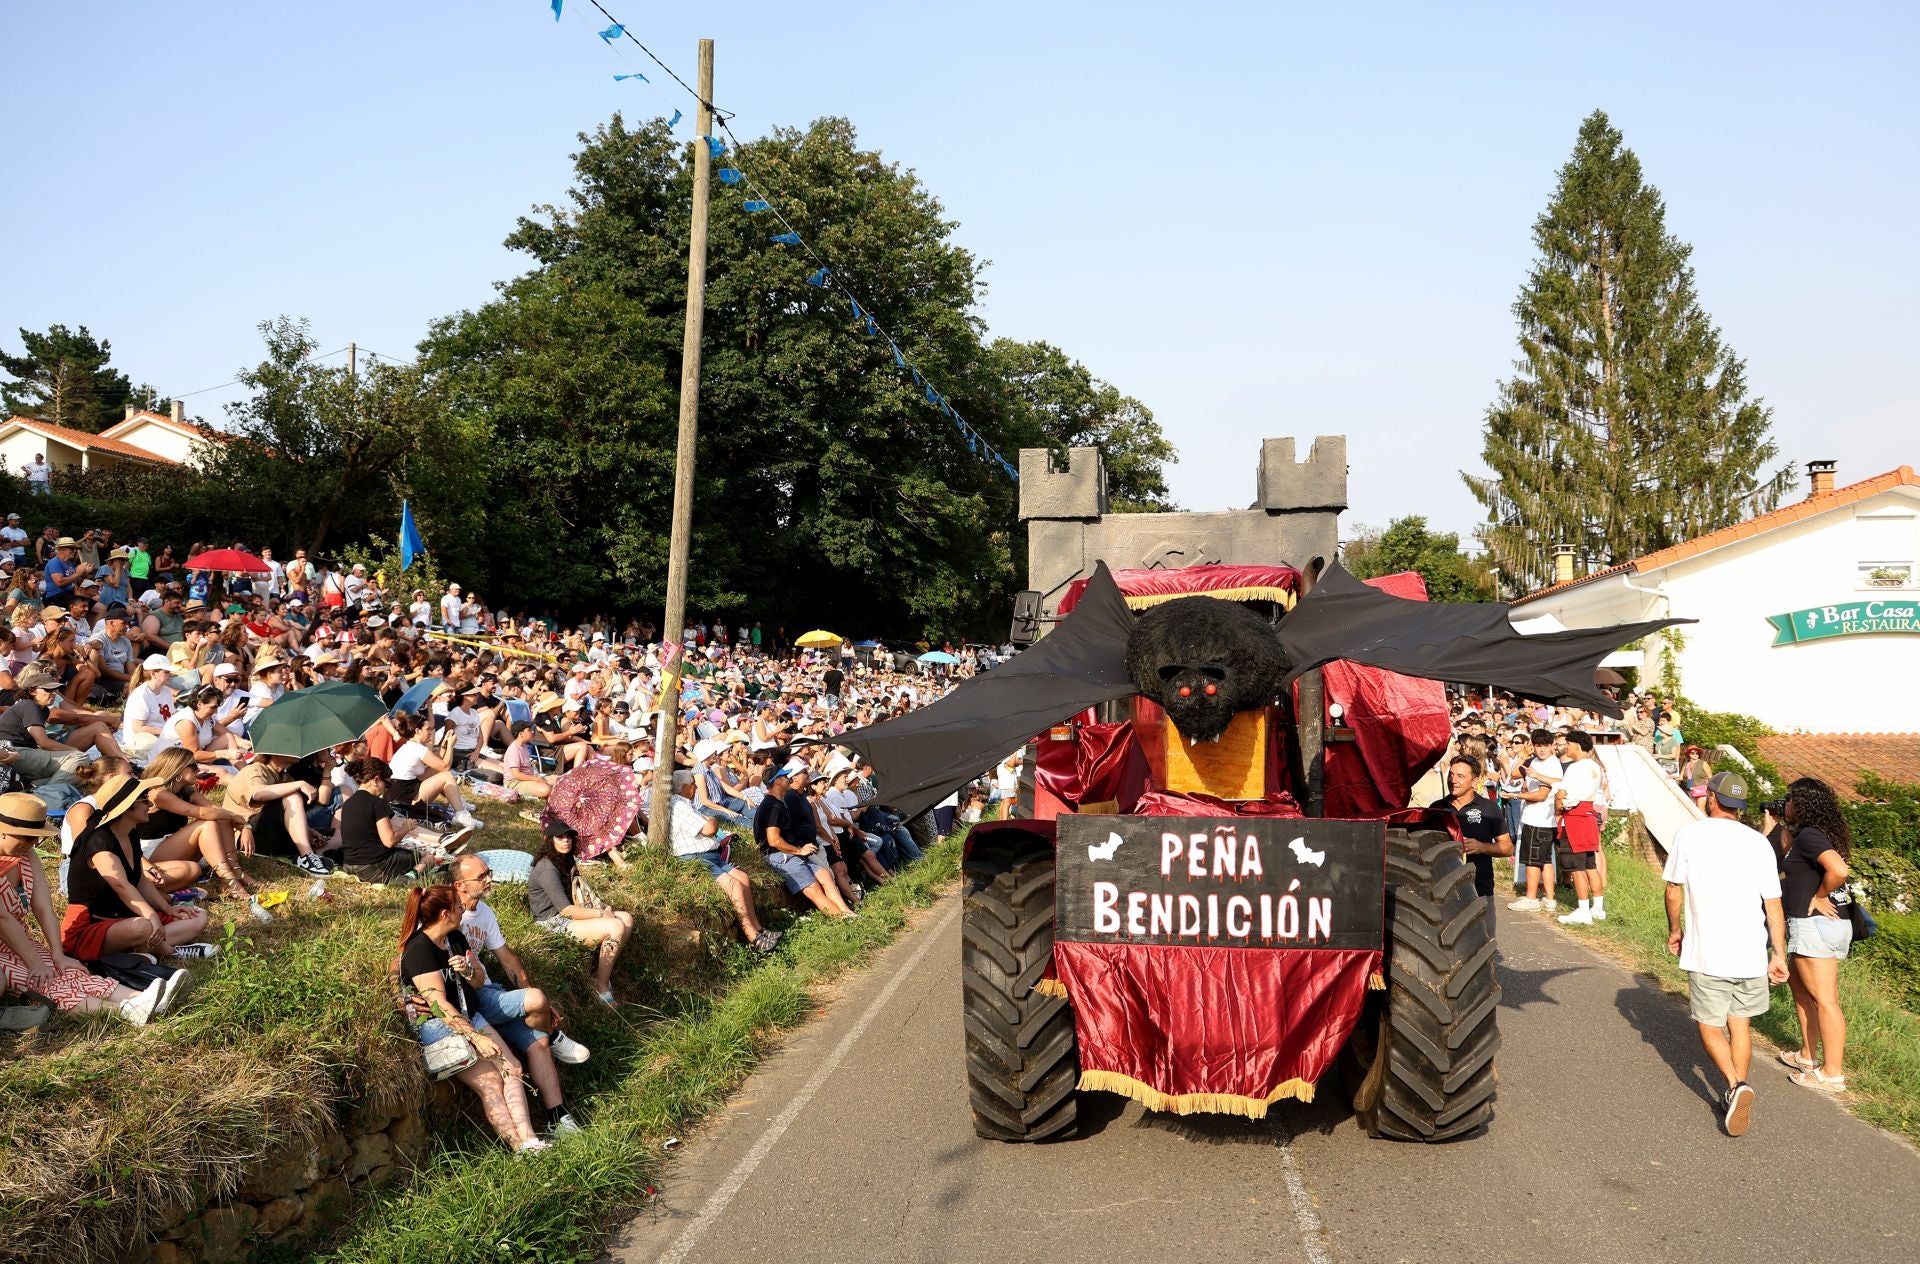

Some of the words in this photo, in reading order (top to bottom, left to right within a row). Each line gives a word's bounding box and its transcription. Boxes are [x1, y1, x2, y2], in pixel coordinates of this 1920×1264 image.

[1821, 606, 1860, 624] Bar
[1865, 601, 1916, 618] Casa
[1160, 825, 1264, 880] PEÑA
[1092, 878, 1333, 941] BENDICIÓN
